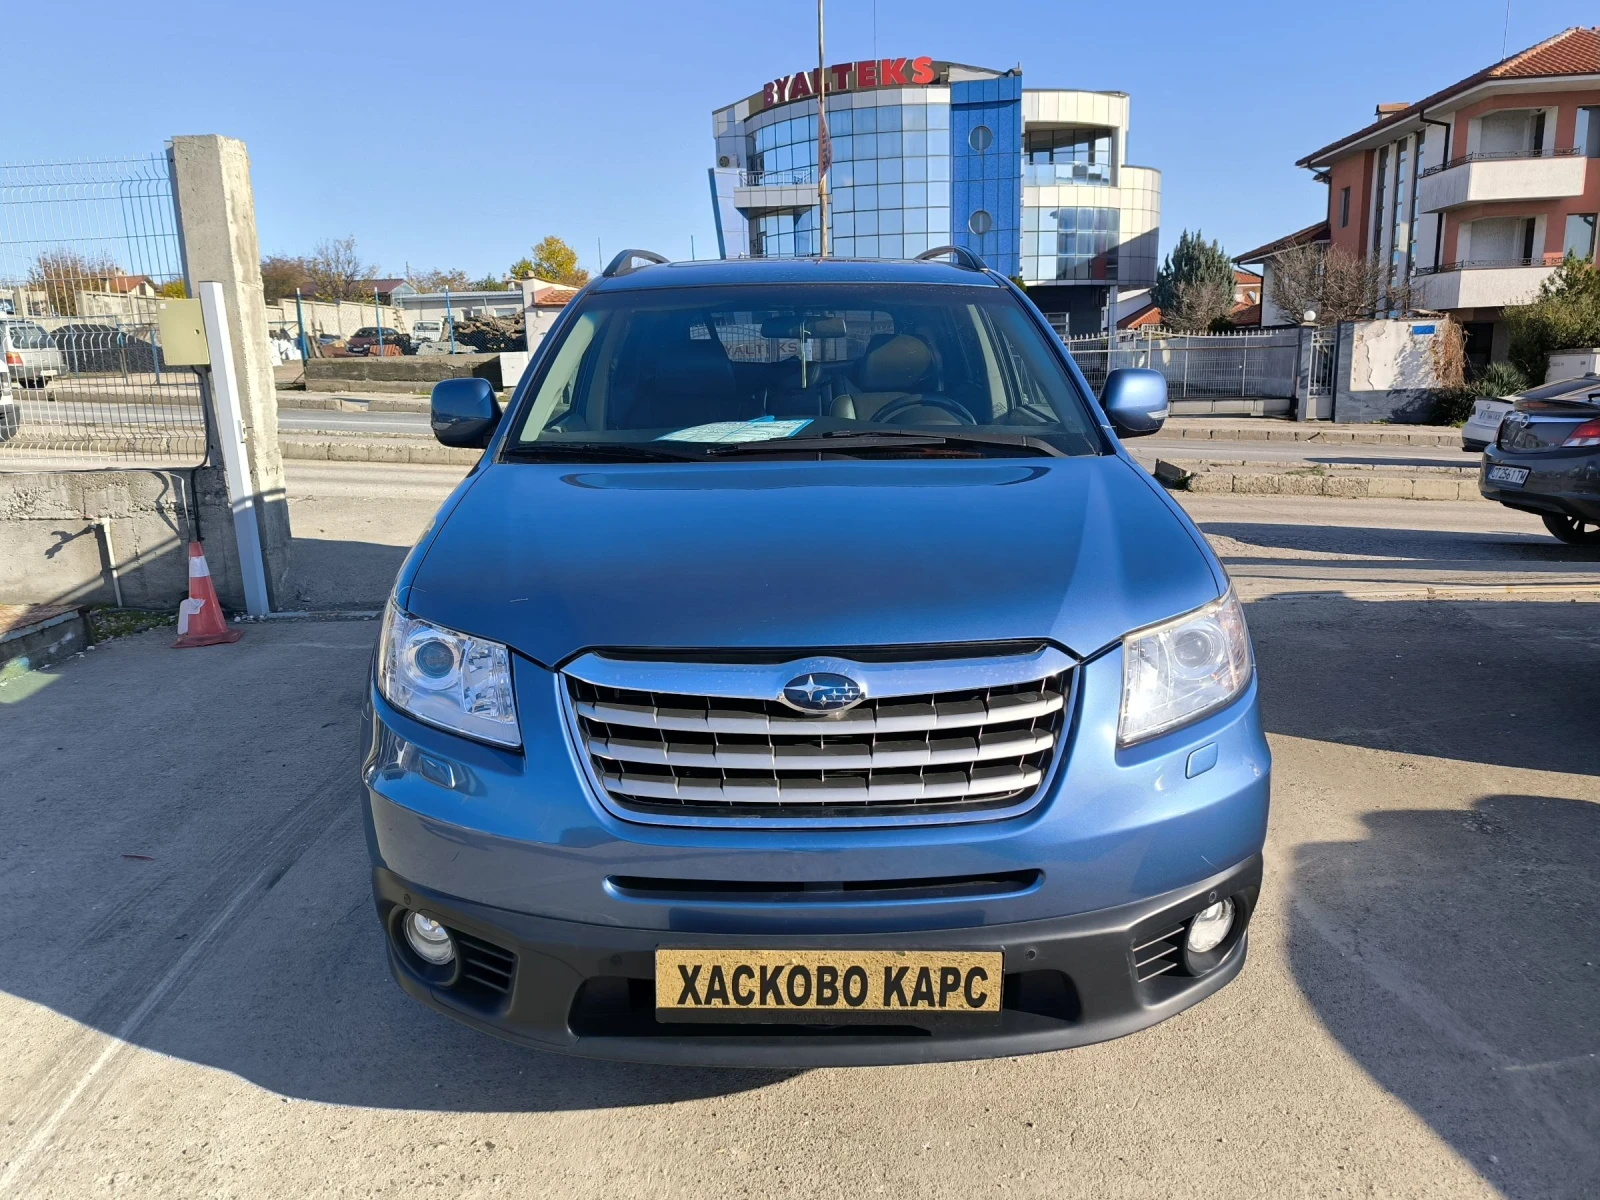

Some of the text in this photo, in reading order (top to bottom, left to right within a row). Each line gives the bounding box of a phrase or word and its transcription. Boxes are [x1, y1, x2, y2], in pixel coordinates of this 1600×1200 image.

[763, 56, 935, 108] BYALTEKS
[677, 965, 989, 1008] ХАСКОВО КАРС
